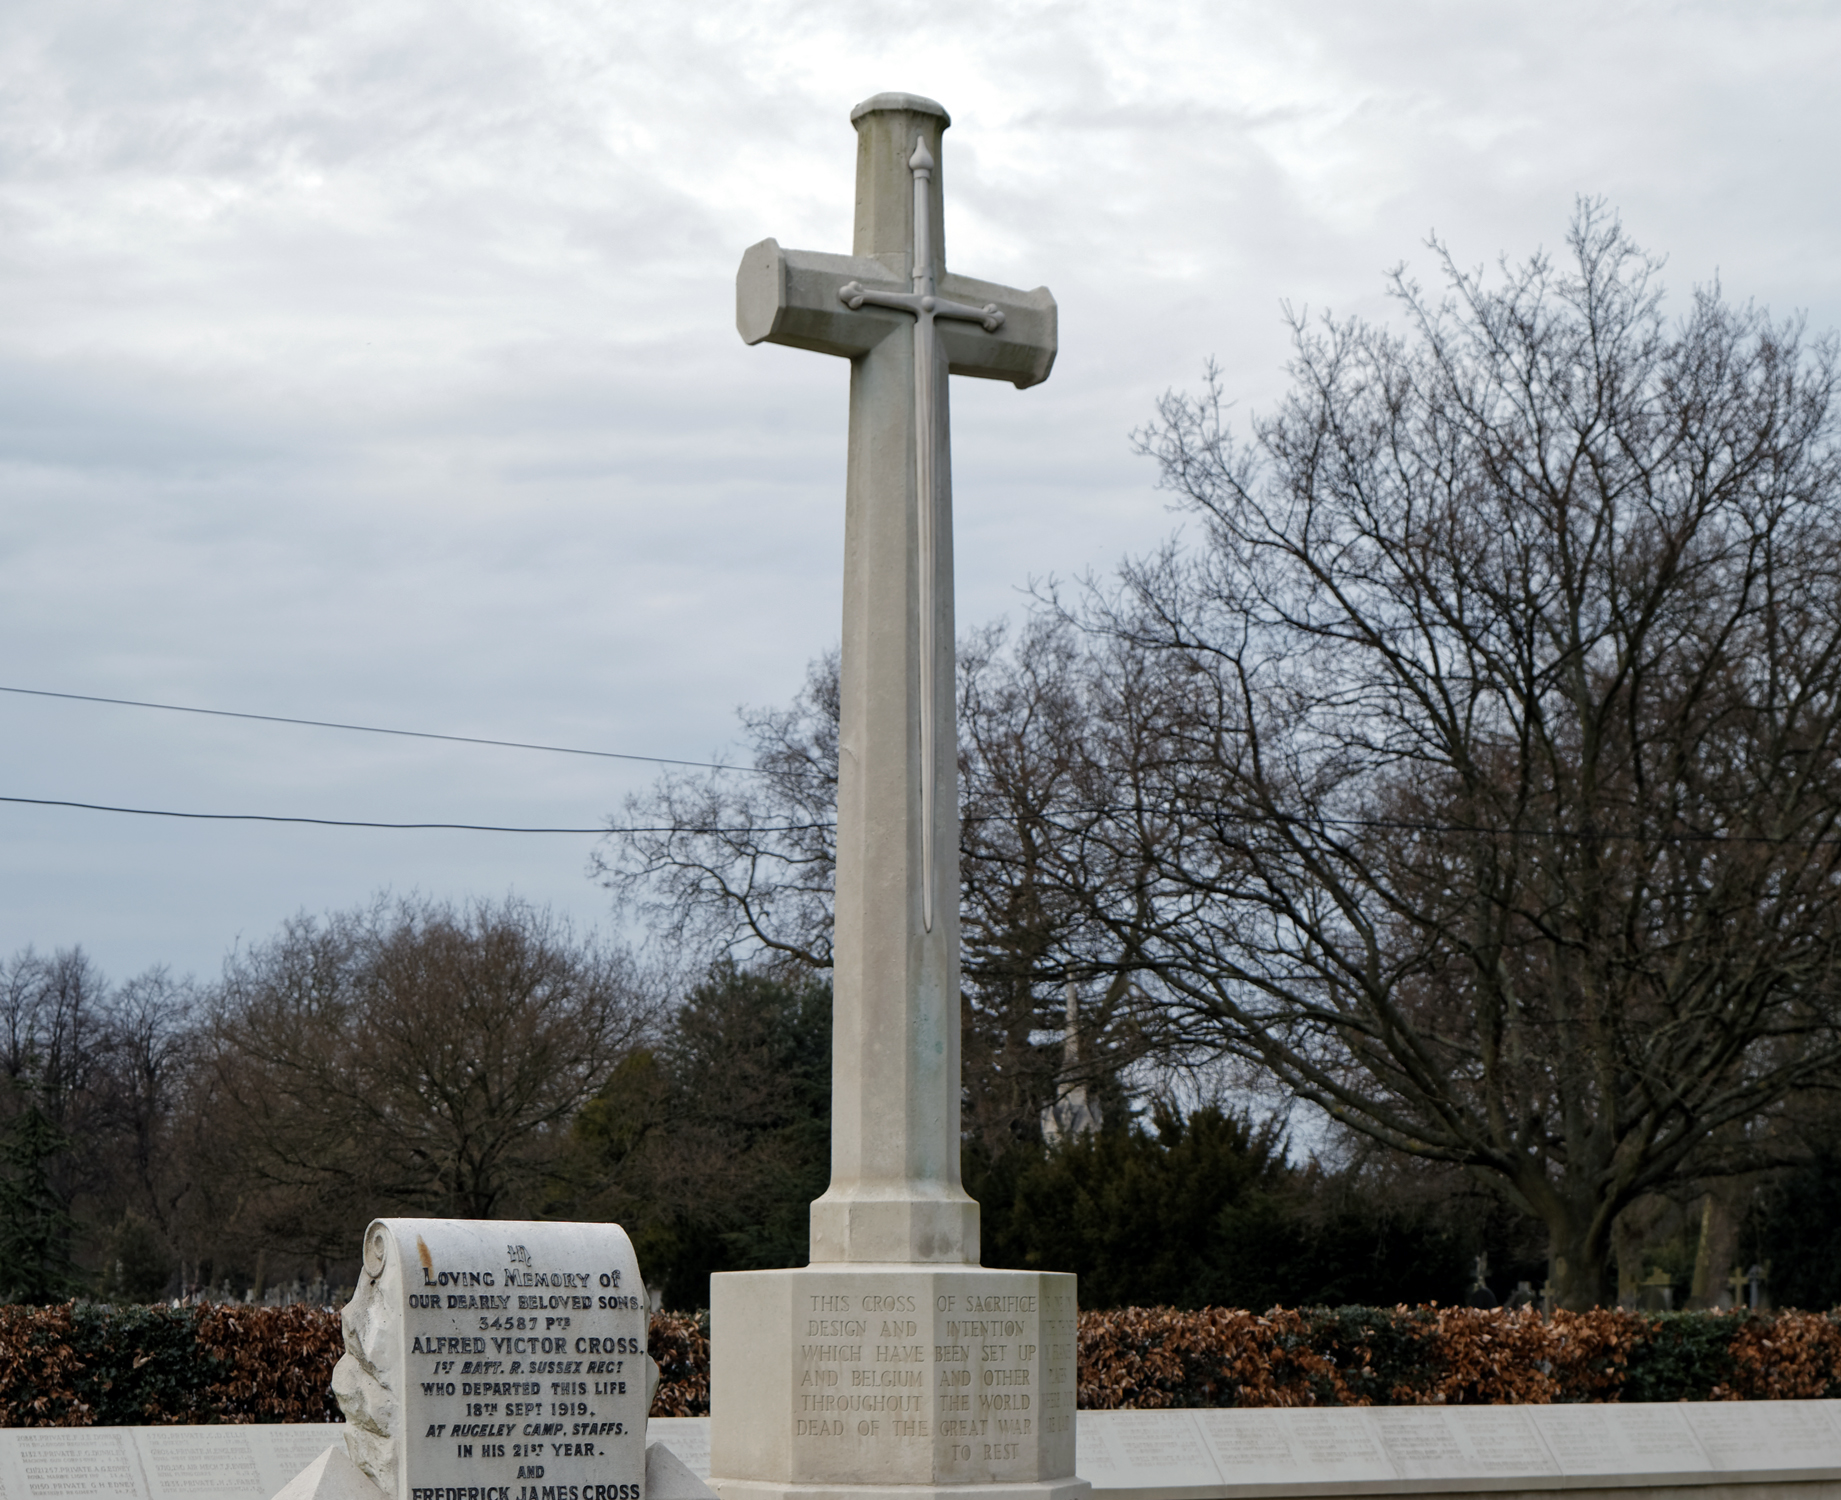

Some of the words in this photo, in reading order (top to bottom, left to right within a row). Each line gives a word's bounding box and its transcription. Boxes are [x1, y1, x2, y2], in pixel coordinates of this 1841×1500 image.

[424, 1268, 494, 1287] LOVING
[504, 1269, 589, 1287] MEMORY
[409, 1294, 441, 1308] OUR
[447, 1295, 510, 1309] DEARLY
[518, 1296, 592, 1309] BELOVED
[811, 1296, 850, 1311] THIS
[862, 1296, 916, 1311] CROSS
[936, 1296, 956, 1311] OF
[966, 1296, 1036, 1312] SACRIFICE
[479, 1317, 537, 1329] 34587
[809, 1320, 867, 1337] DESIGN
[880, 1321, 917, 1336] AND
[947, 1321, 1024, 1336] INTENTION
[412, 1337, 485, 1354] ALFRED
[491, 1337, 567, 1354] VICTOR
[802, 1346, 862, 1361] WHICH
[877, 1346, 924, 1362] HAVE
[935, 1346, 969, 1361] BEEN
[982, 1346, 1006, 1361] SET
[1019, 1346, 1036, 1361] UP
[510, 1362, 524, 1374] R.
[530, 1362, 582, 1373] SUSSEX
[801, 1371, 838, 1386] AND
[852, 1371, 923, 1386] BELGIUM
[939, 1371, 971, 1386] AND
[984, 1369, 1030, 1386] OTHER
[421, 1383, 455, 1395] WHO
[463, 1383, 540, 1395] DEPARTED
[551, 1383, 586, 1394] THIS
[595, 1382, 626, 1394] LIFE
[552, 1403, 595, 1417] 1919.
[802, 1396, 922, 1411] THROUGHOUT
[941, 1396, 969, 1411] THE
[980, 1395, 1031, 1410] WORLD
[425, 1424, 445, 1437] AT
[451, 1424, 516, 1437] RUGELEY
[797, 1420, 844, 1436] DEAD
[858, 1420, 880, 1436] OF
[892, 1421, 928, 1436] THE
[939, 1420, 988, 1436] GREAT
[998, 1419, 1031, 1434] WAR
[458, 1445, 473, 1457] IN
[482, 1445, 504, 1457] HIS
[952, 1444, 971, 1460] TO
[984, 1444, 1019, 1459] REST
[517, 1466, 545, 1478] AND
[583, 1485, 640, 1500] CROSS
